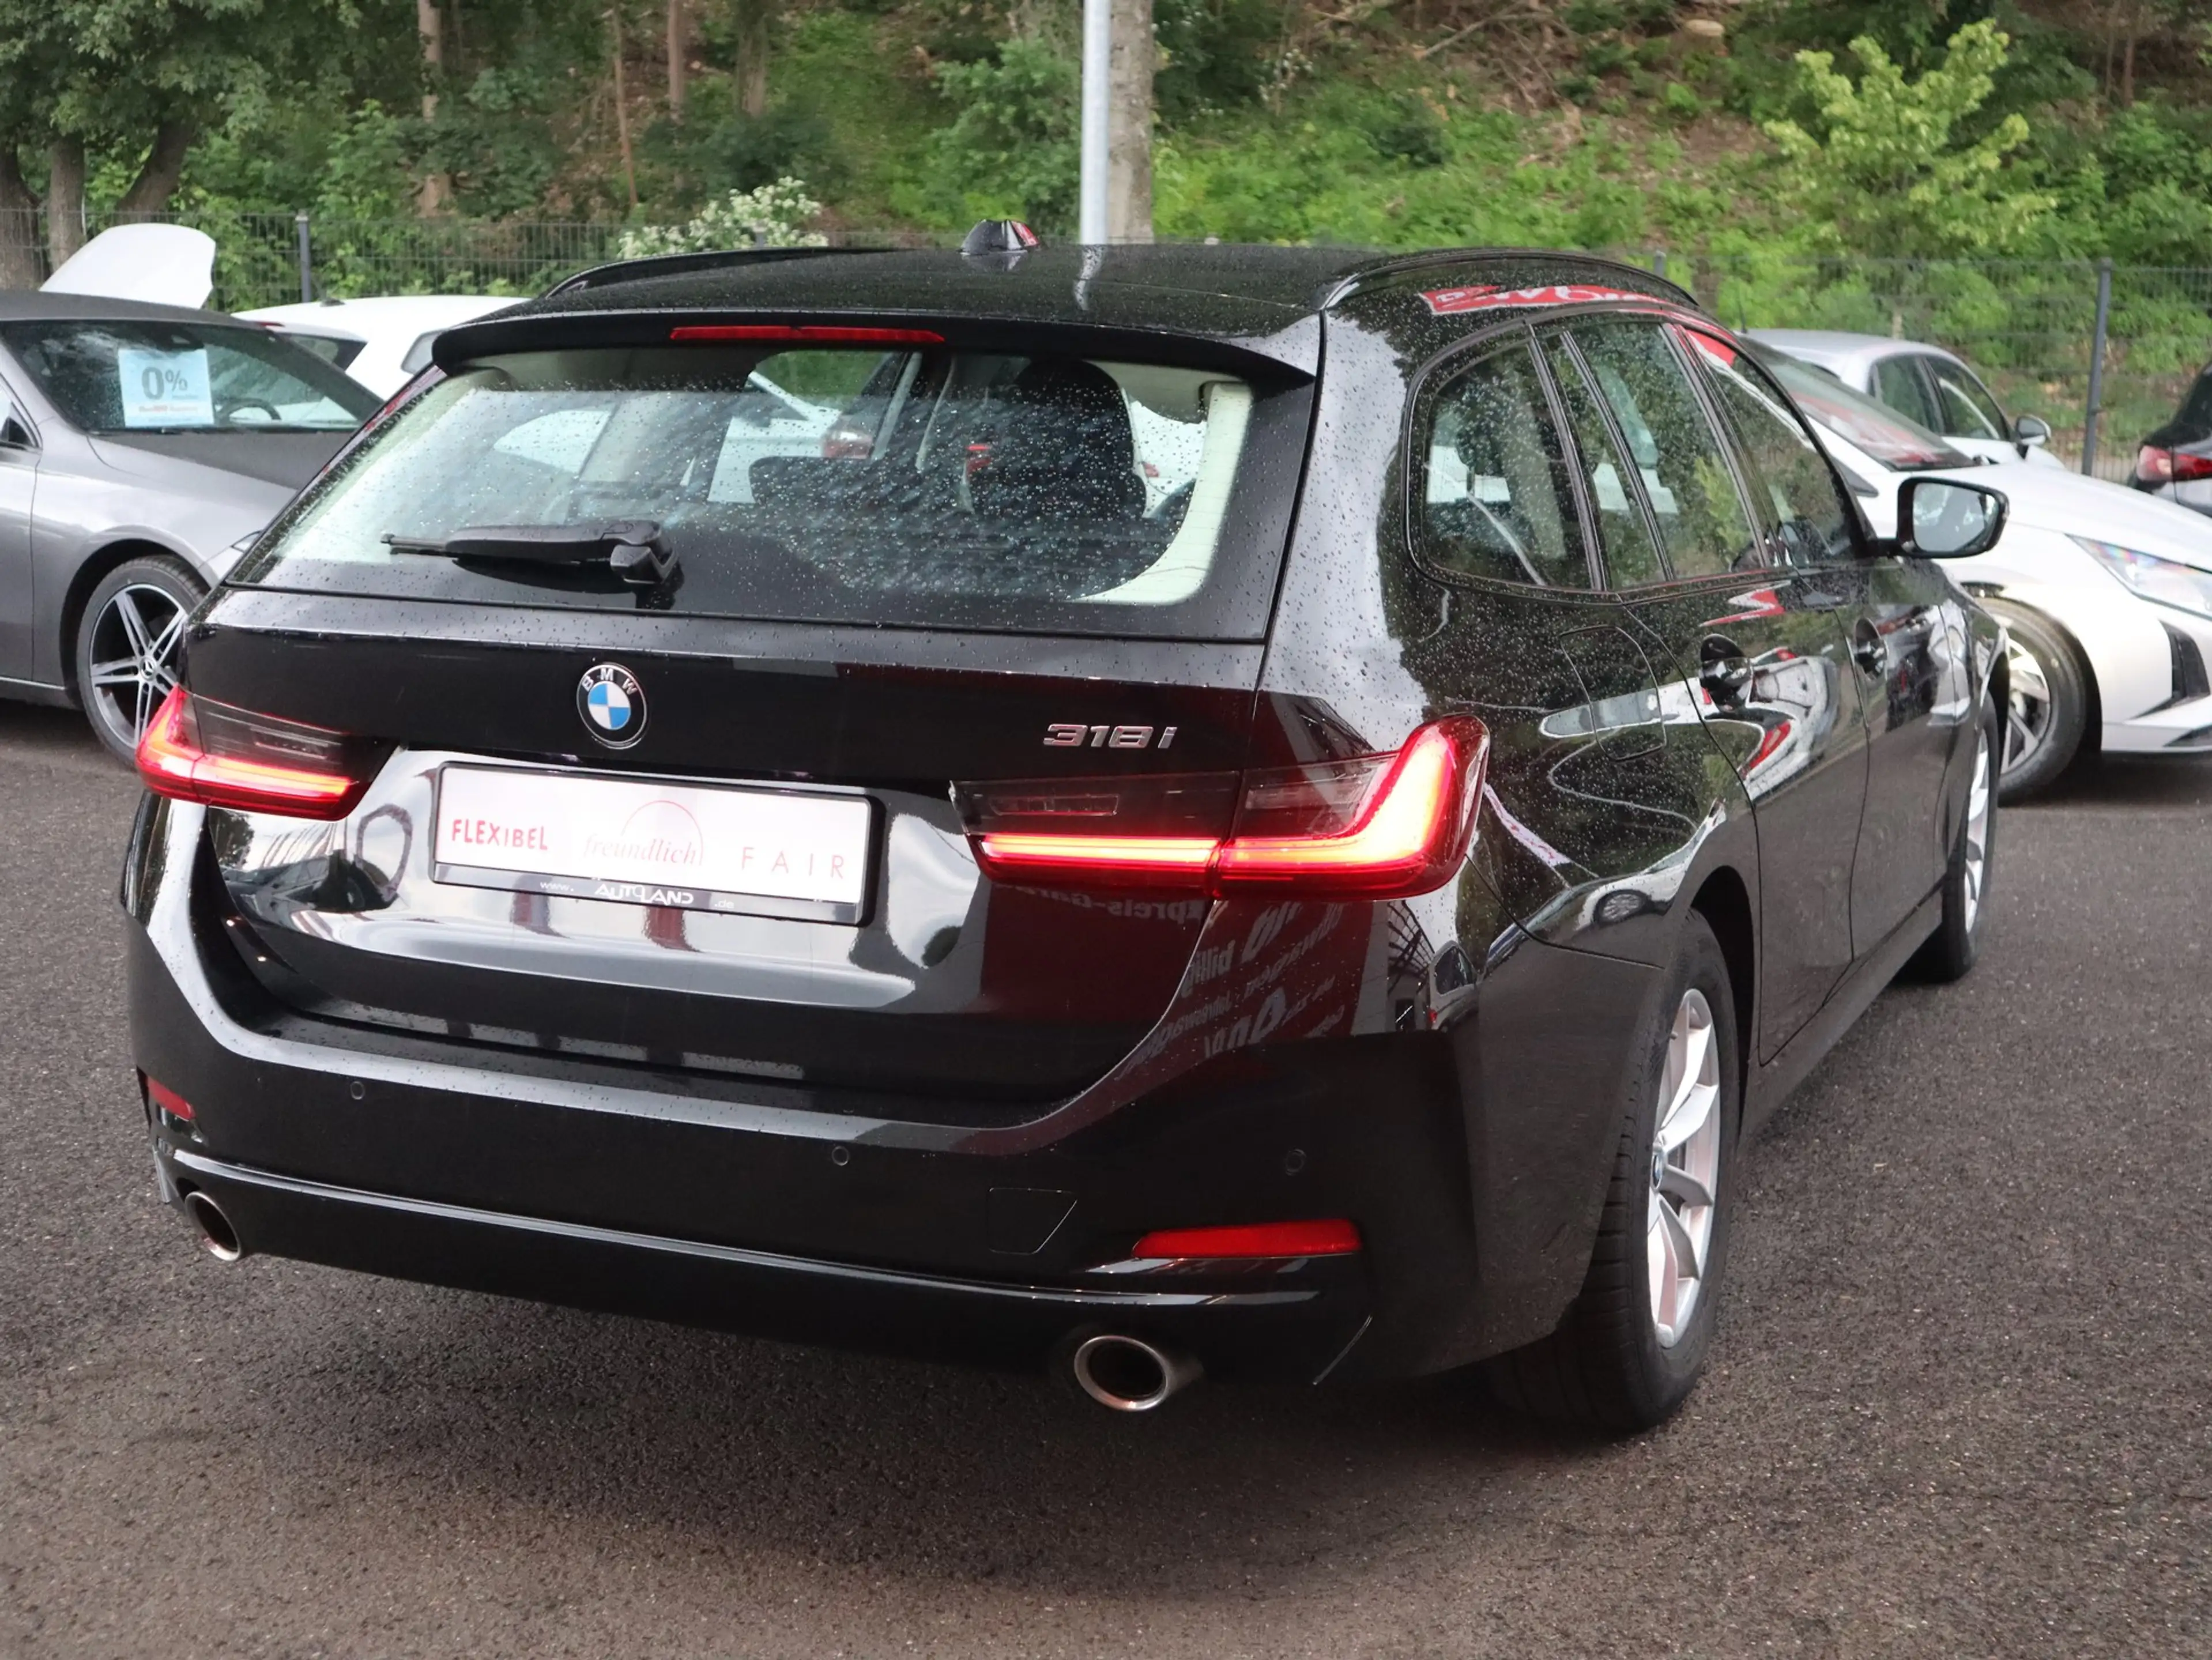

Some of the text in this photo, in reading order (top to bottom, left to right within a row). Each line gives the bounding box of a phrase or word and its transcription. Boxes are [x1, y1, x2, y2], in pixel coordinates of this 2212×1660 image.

[141, 367, 188, 400] 0%
[581, 667, 638, 695] BMW
[452, 818, 845, 880] FLEXIBEL freundlich FAIR
